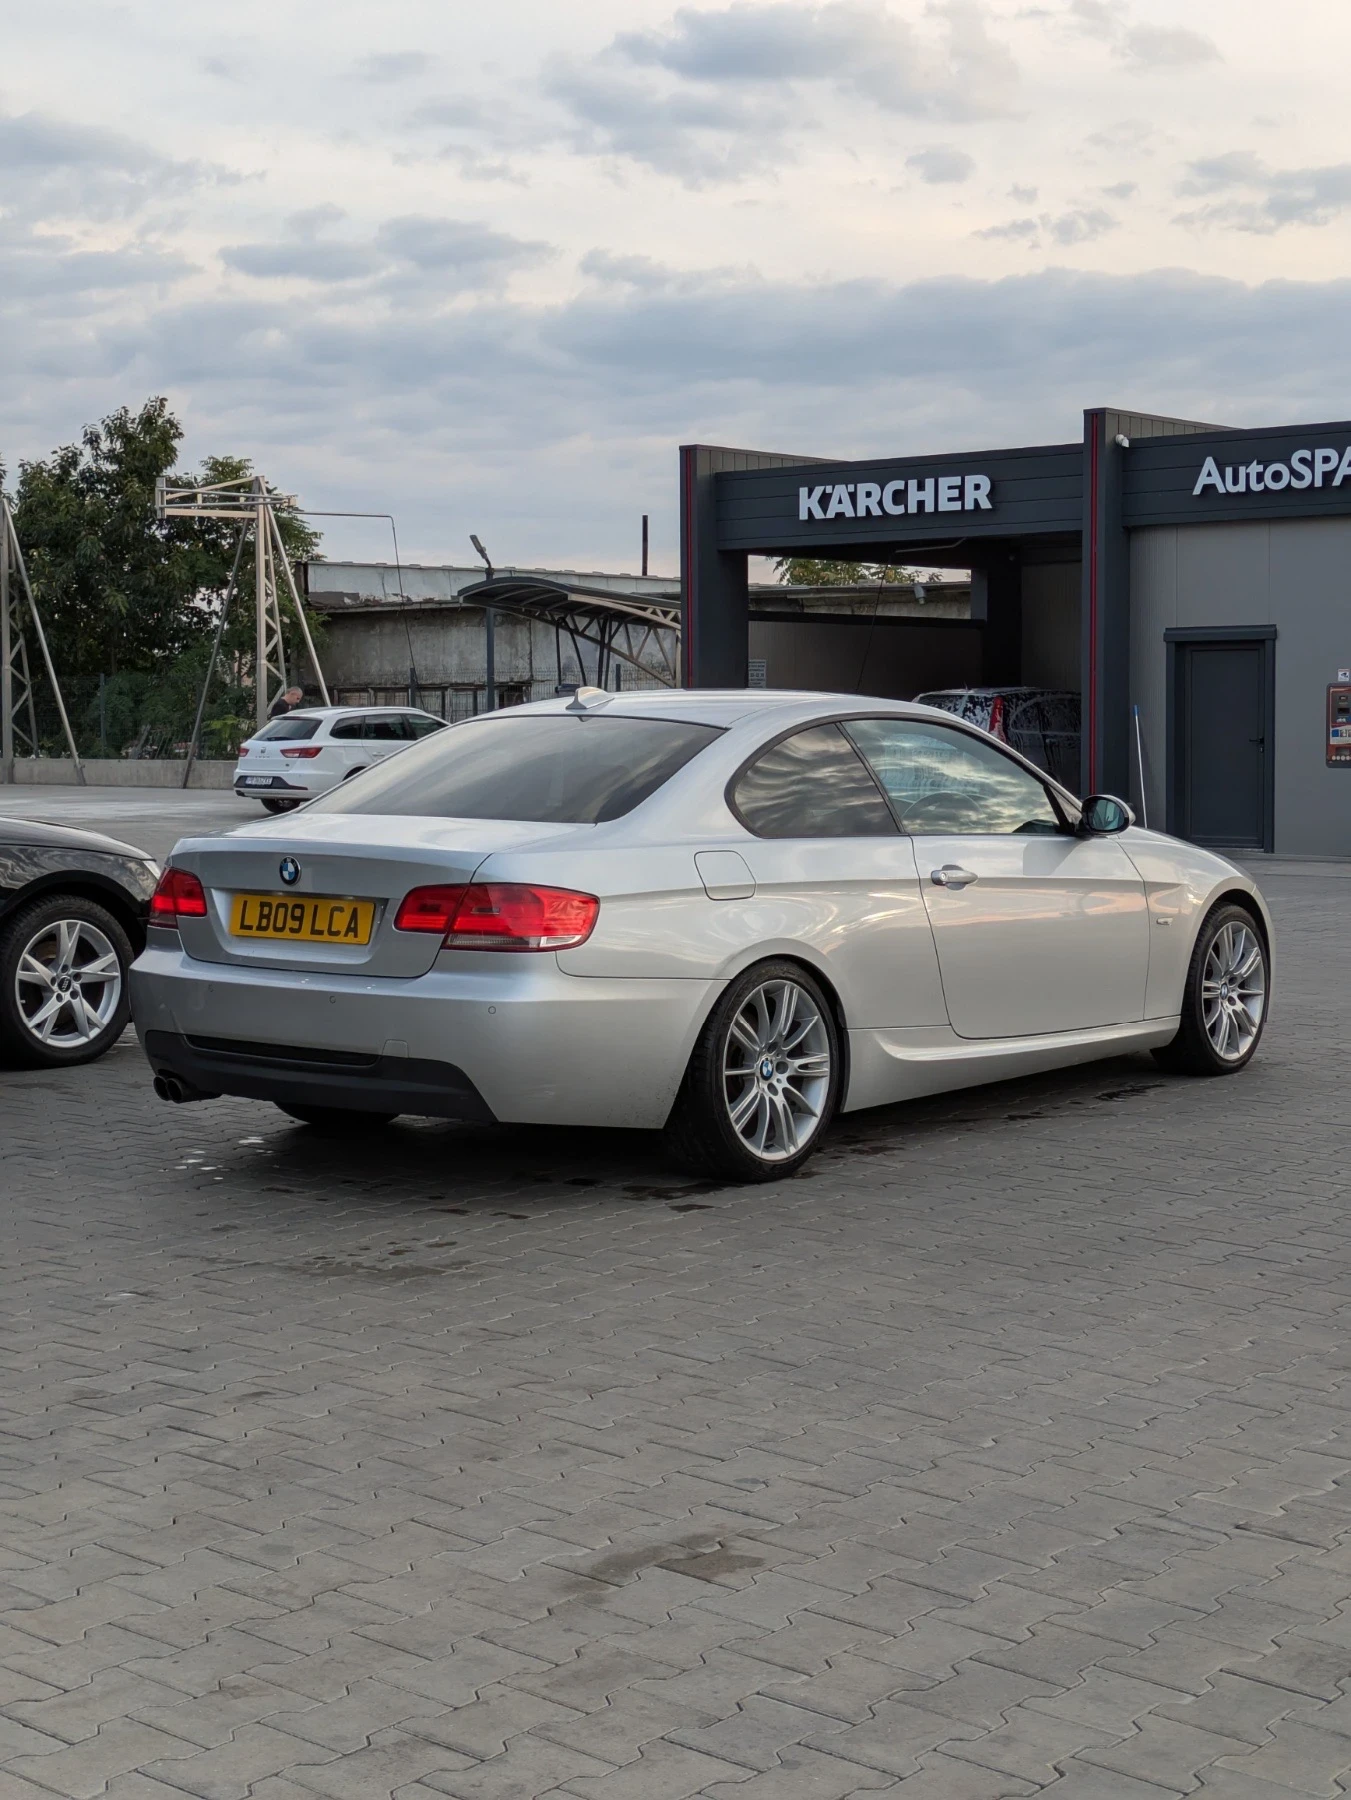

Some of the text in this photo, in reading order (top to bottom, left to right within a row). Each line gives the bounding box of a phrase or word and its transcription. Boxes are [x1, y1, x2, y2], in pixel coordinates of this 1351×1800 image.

[799, 474, 993, 521] KÄRCHER
[239, 900, 359, 938] LB09 LCA
